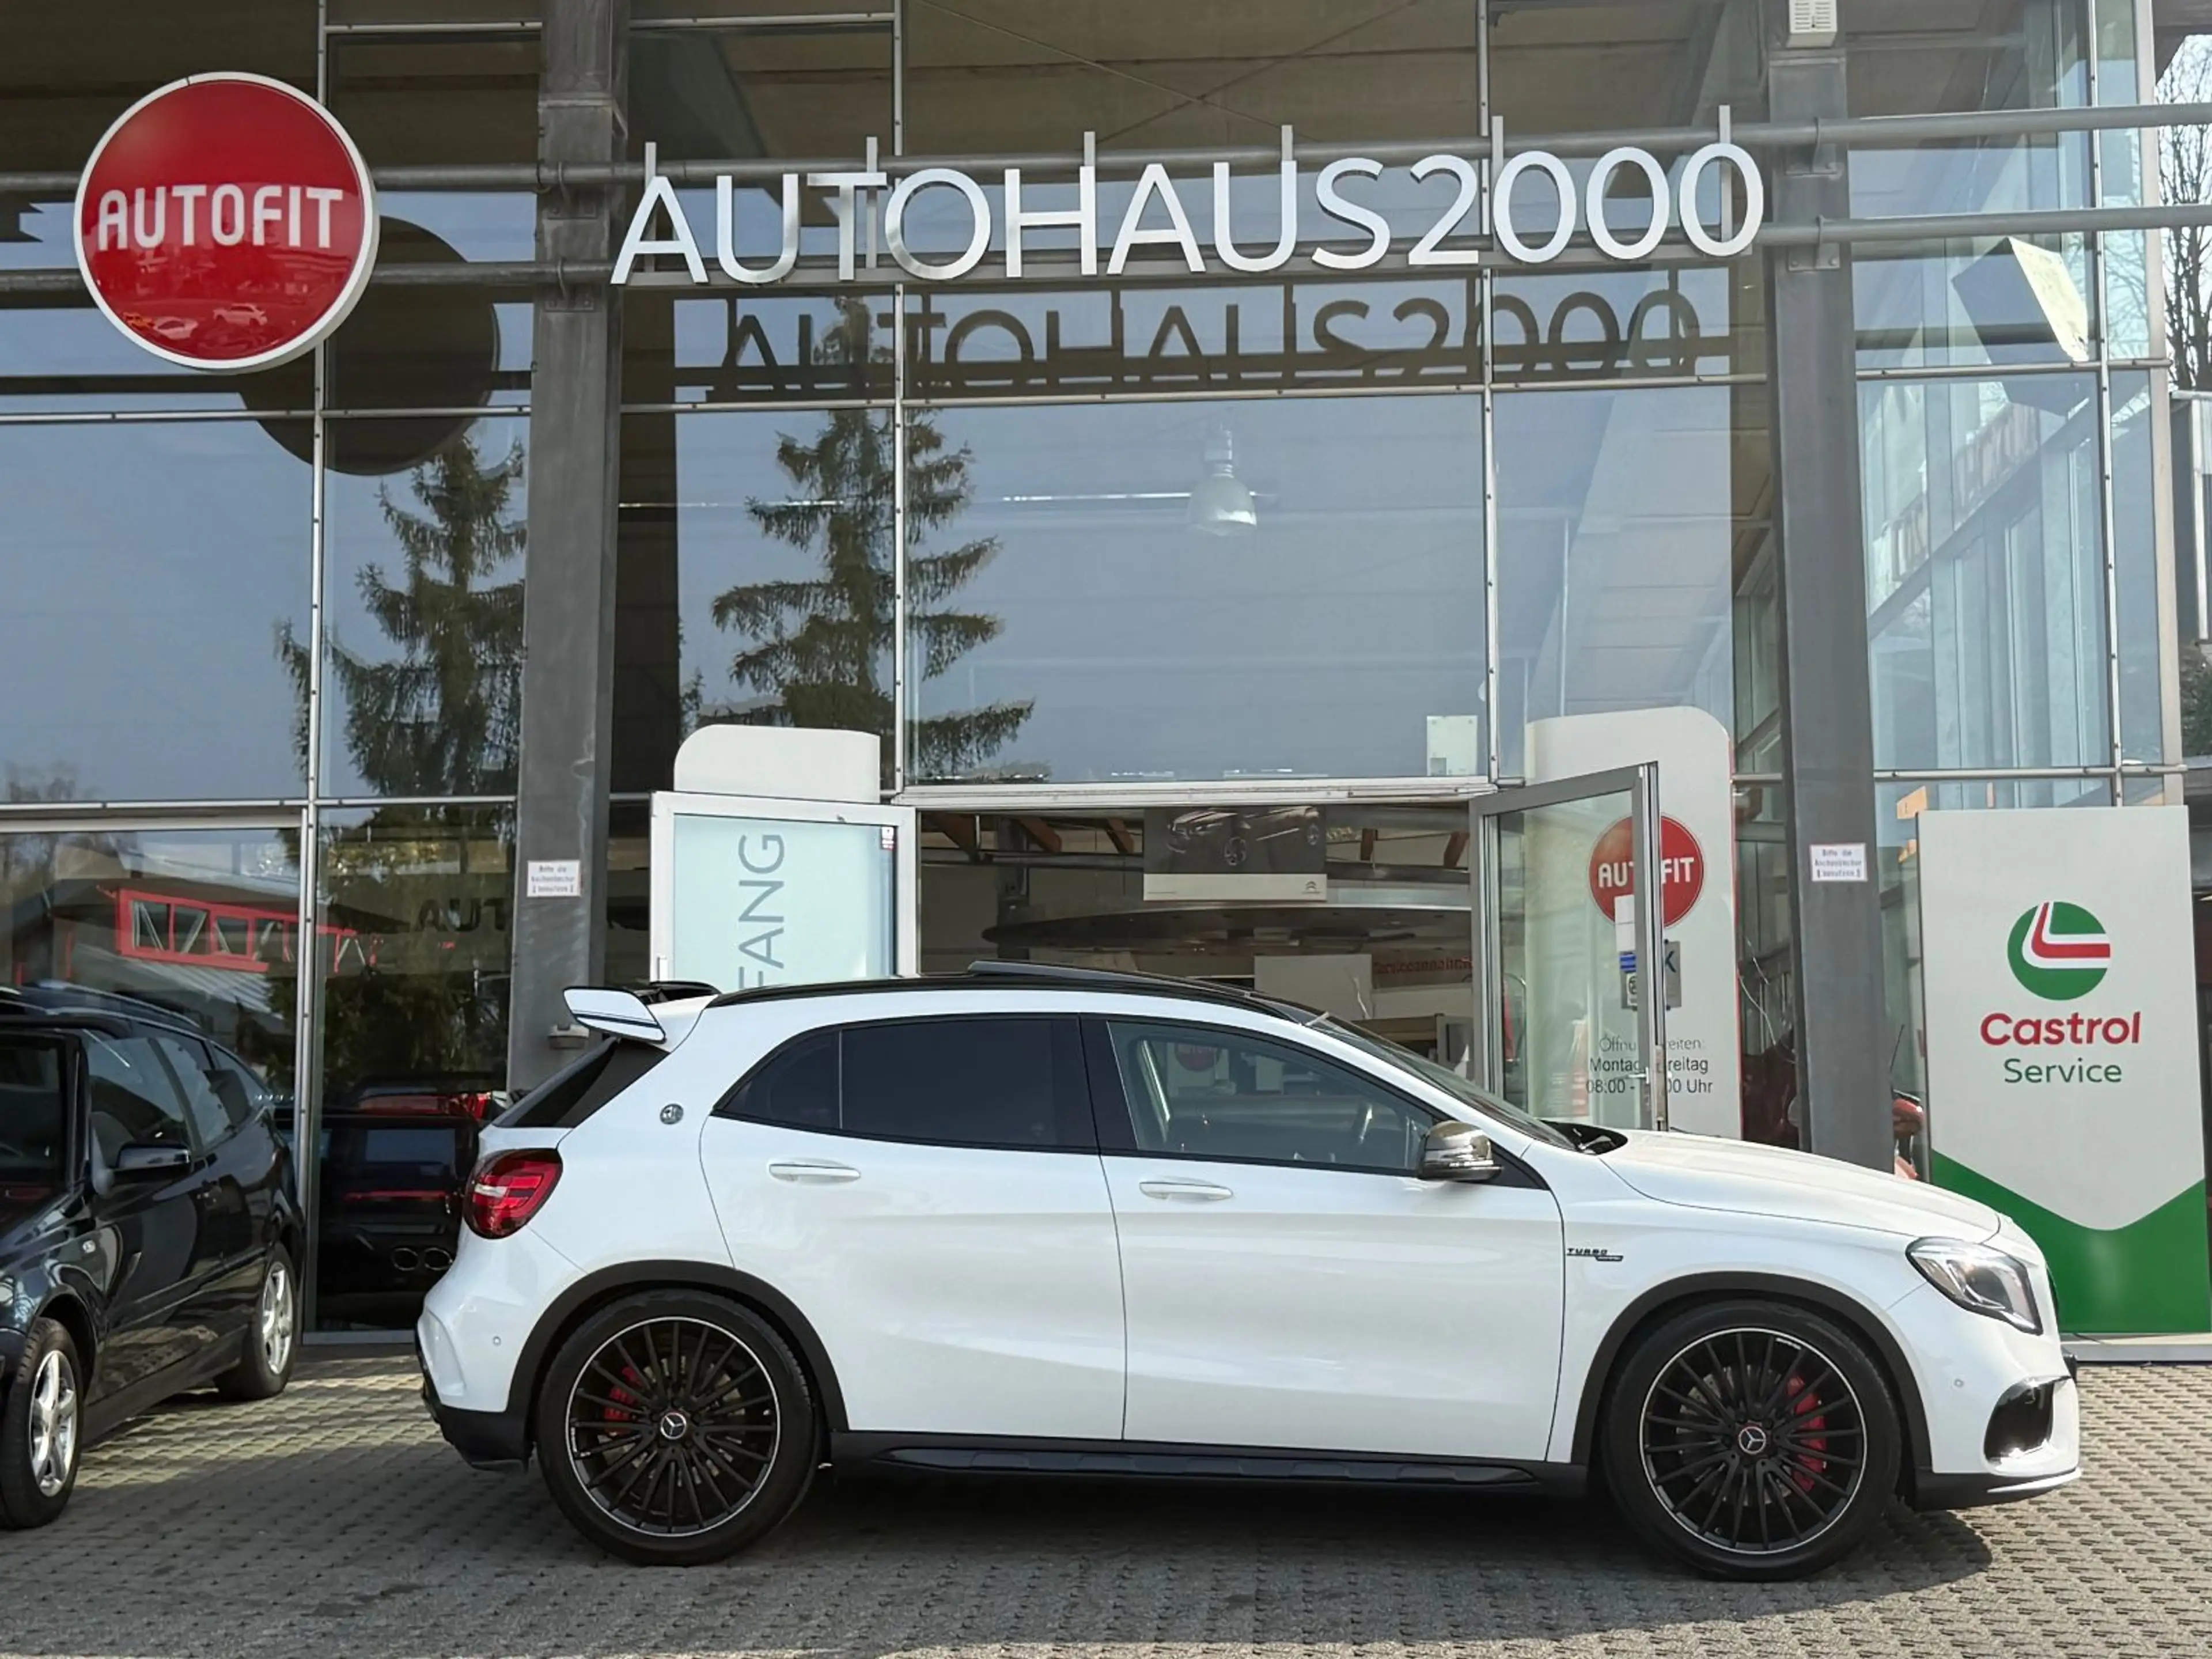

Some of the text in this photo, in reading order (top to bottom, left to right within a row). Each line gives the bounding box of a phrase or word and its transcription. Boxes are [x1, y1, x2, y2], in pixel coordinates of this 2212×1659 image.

[98, 183, 344, 252] AUTOFIT
[611, 143, 1763, 286] AUTOHAUS2000
[1597, 857, 1695, 888] AUFIT
[1980, 1012, 2141, 1046] Castrol
[2003, 1058, 2122, 1083] Service
[1687, 1080, 1714, 1094] Uhr
